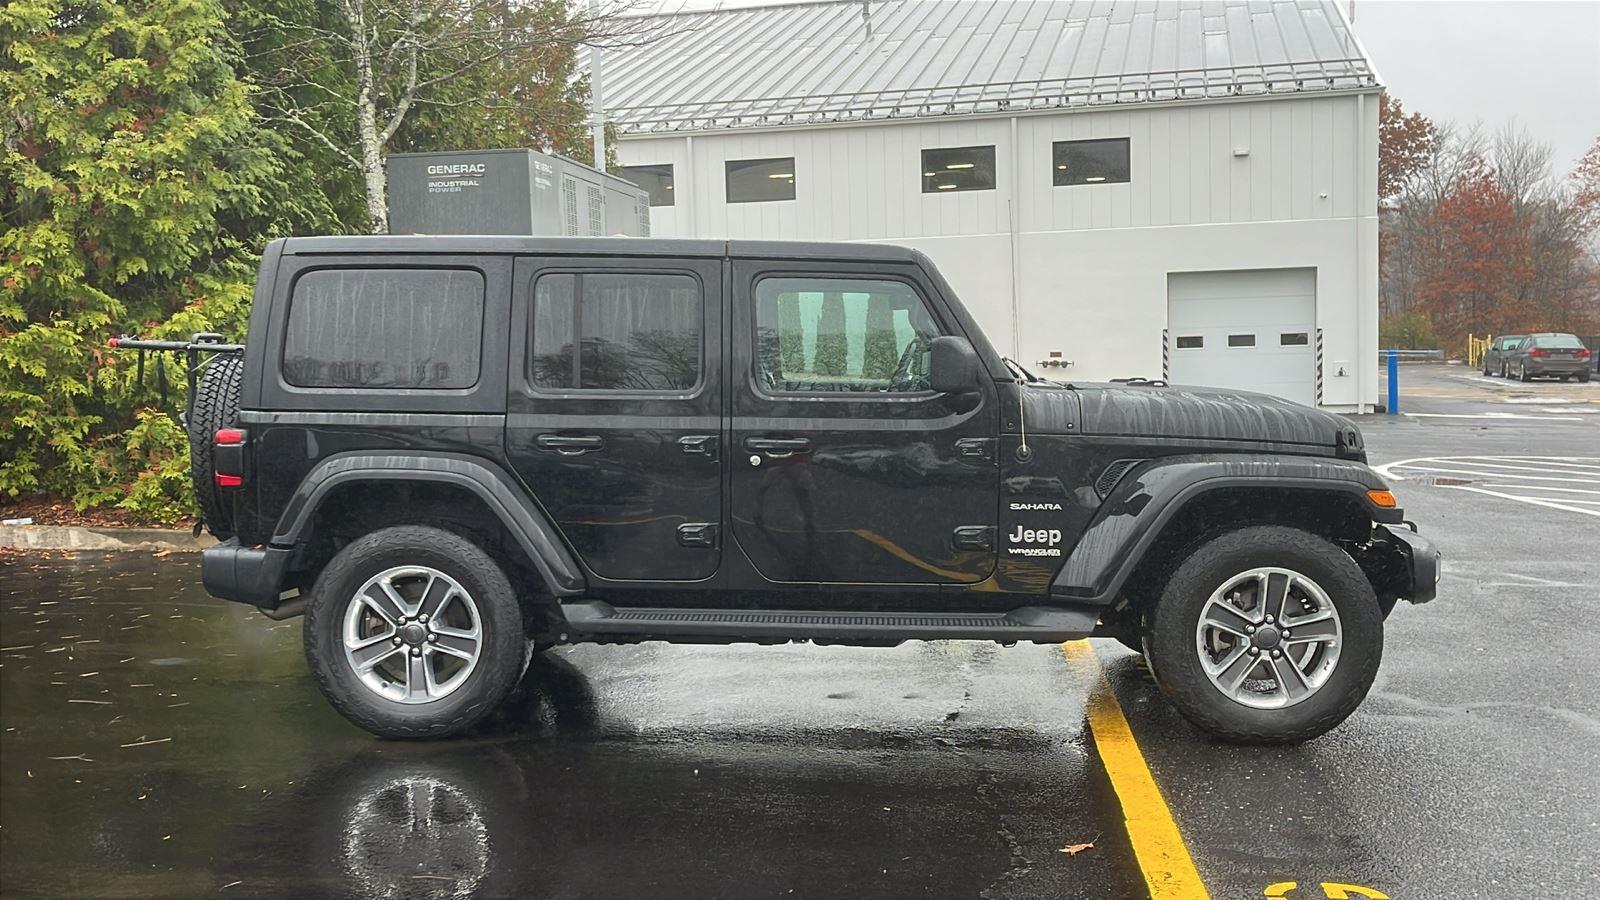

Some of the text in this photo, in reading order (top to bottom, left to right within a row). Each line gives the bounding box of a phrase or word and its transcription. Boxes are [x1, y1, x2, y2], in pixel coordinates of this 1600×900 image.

[427, 163, 486, 175] GENERAC
[428, 180, 480, 188] INDUSTRIAL
[1009, 503, 1062, 511] SAHARA
[1008, 525, 1062, 547] Jeep
